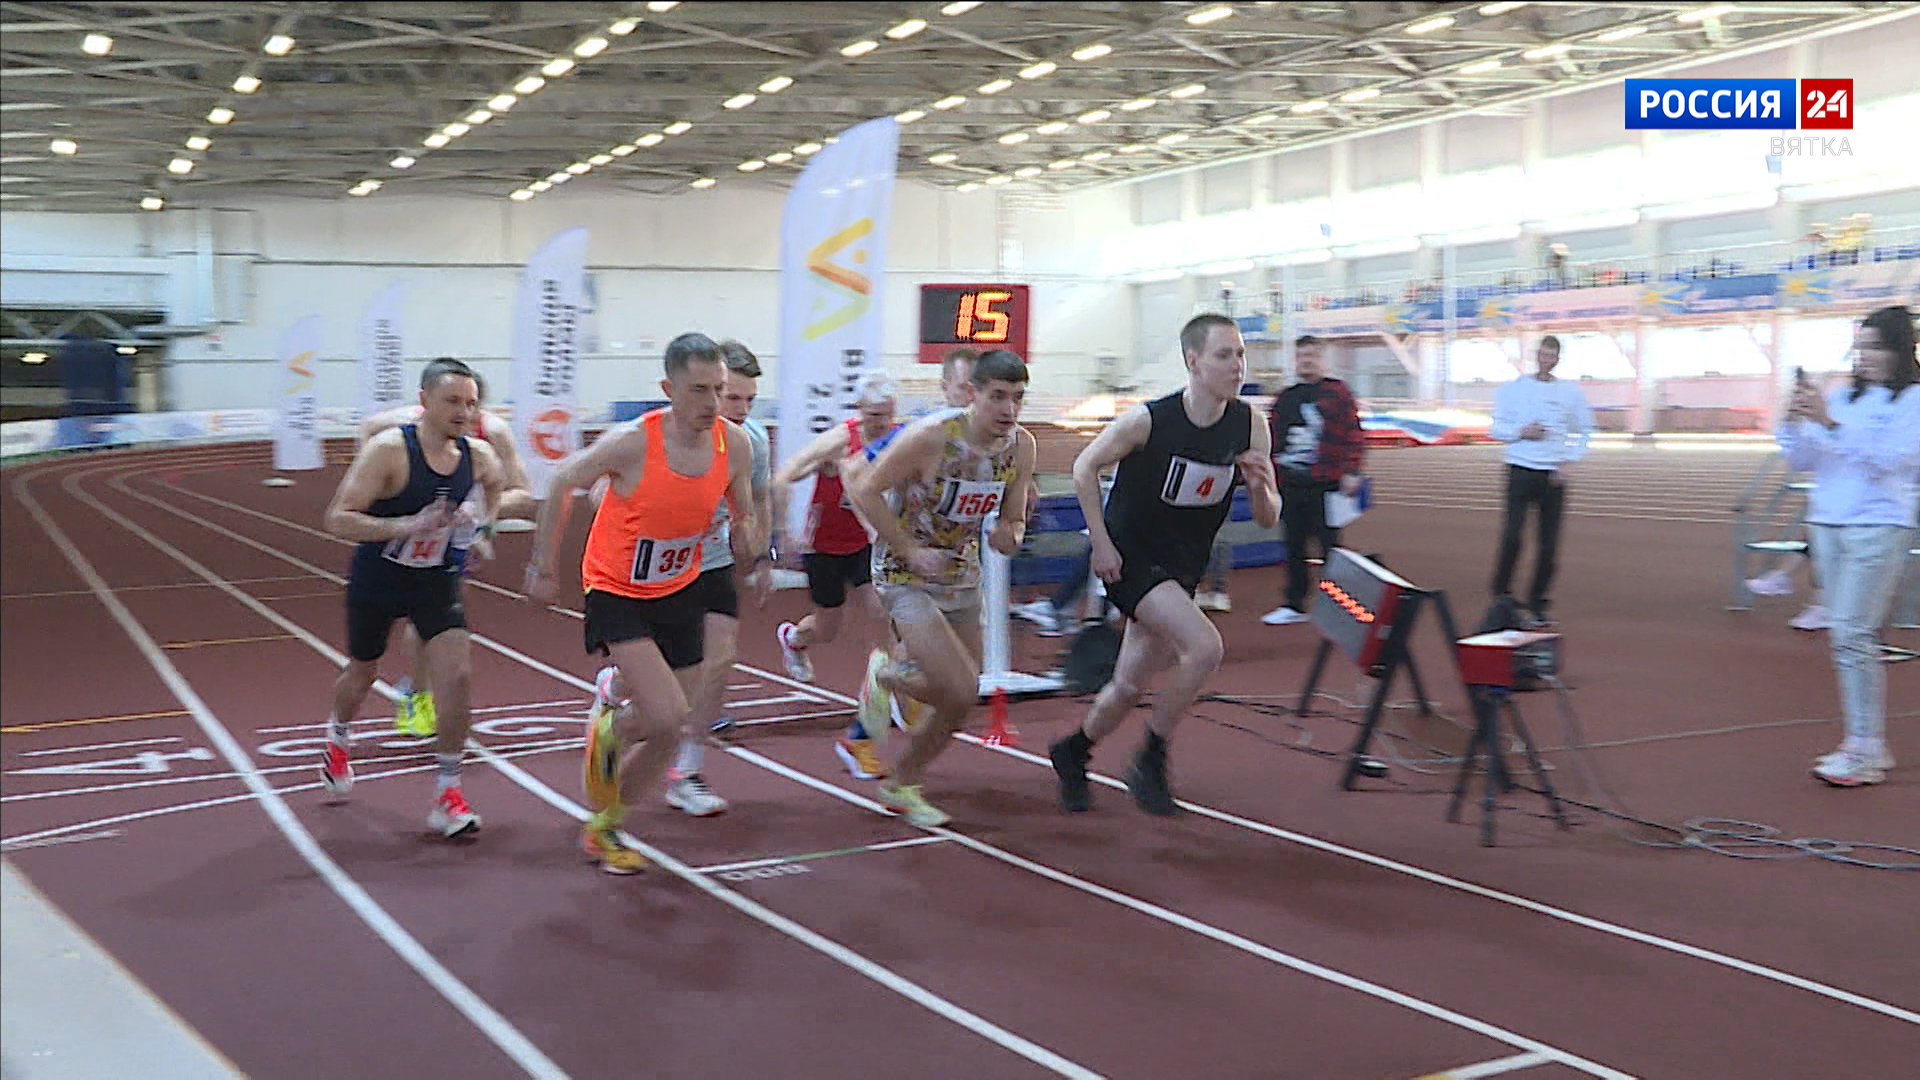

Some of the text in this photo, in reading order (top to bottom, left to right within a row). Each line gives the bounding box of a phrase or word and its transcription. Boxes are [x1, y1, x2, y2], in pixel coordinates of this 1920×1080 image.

[956, 290, 1012, 342] 15
[1196, 476, 1216, 498] 4
[957, 492, 998, 516] 156
[659, 546, 691, 573] 39
